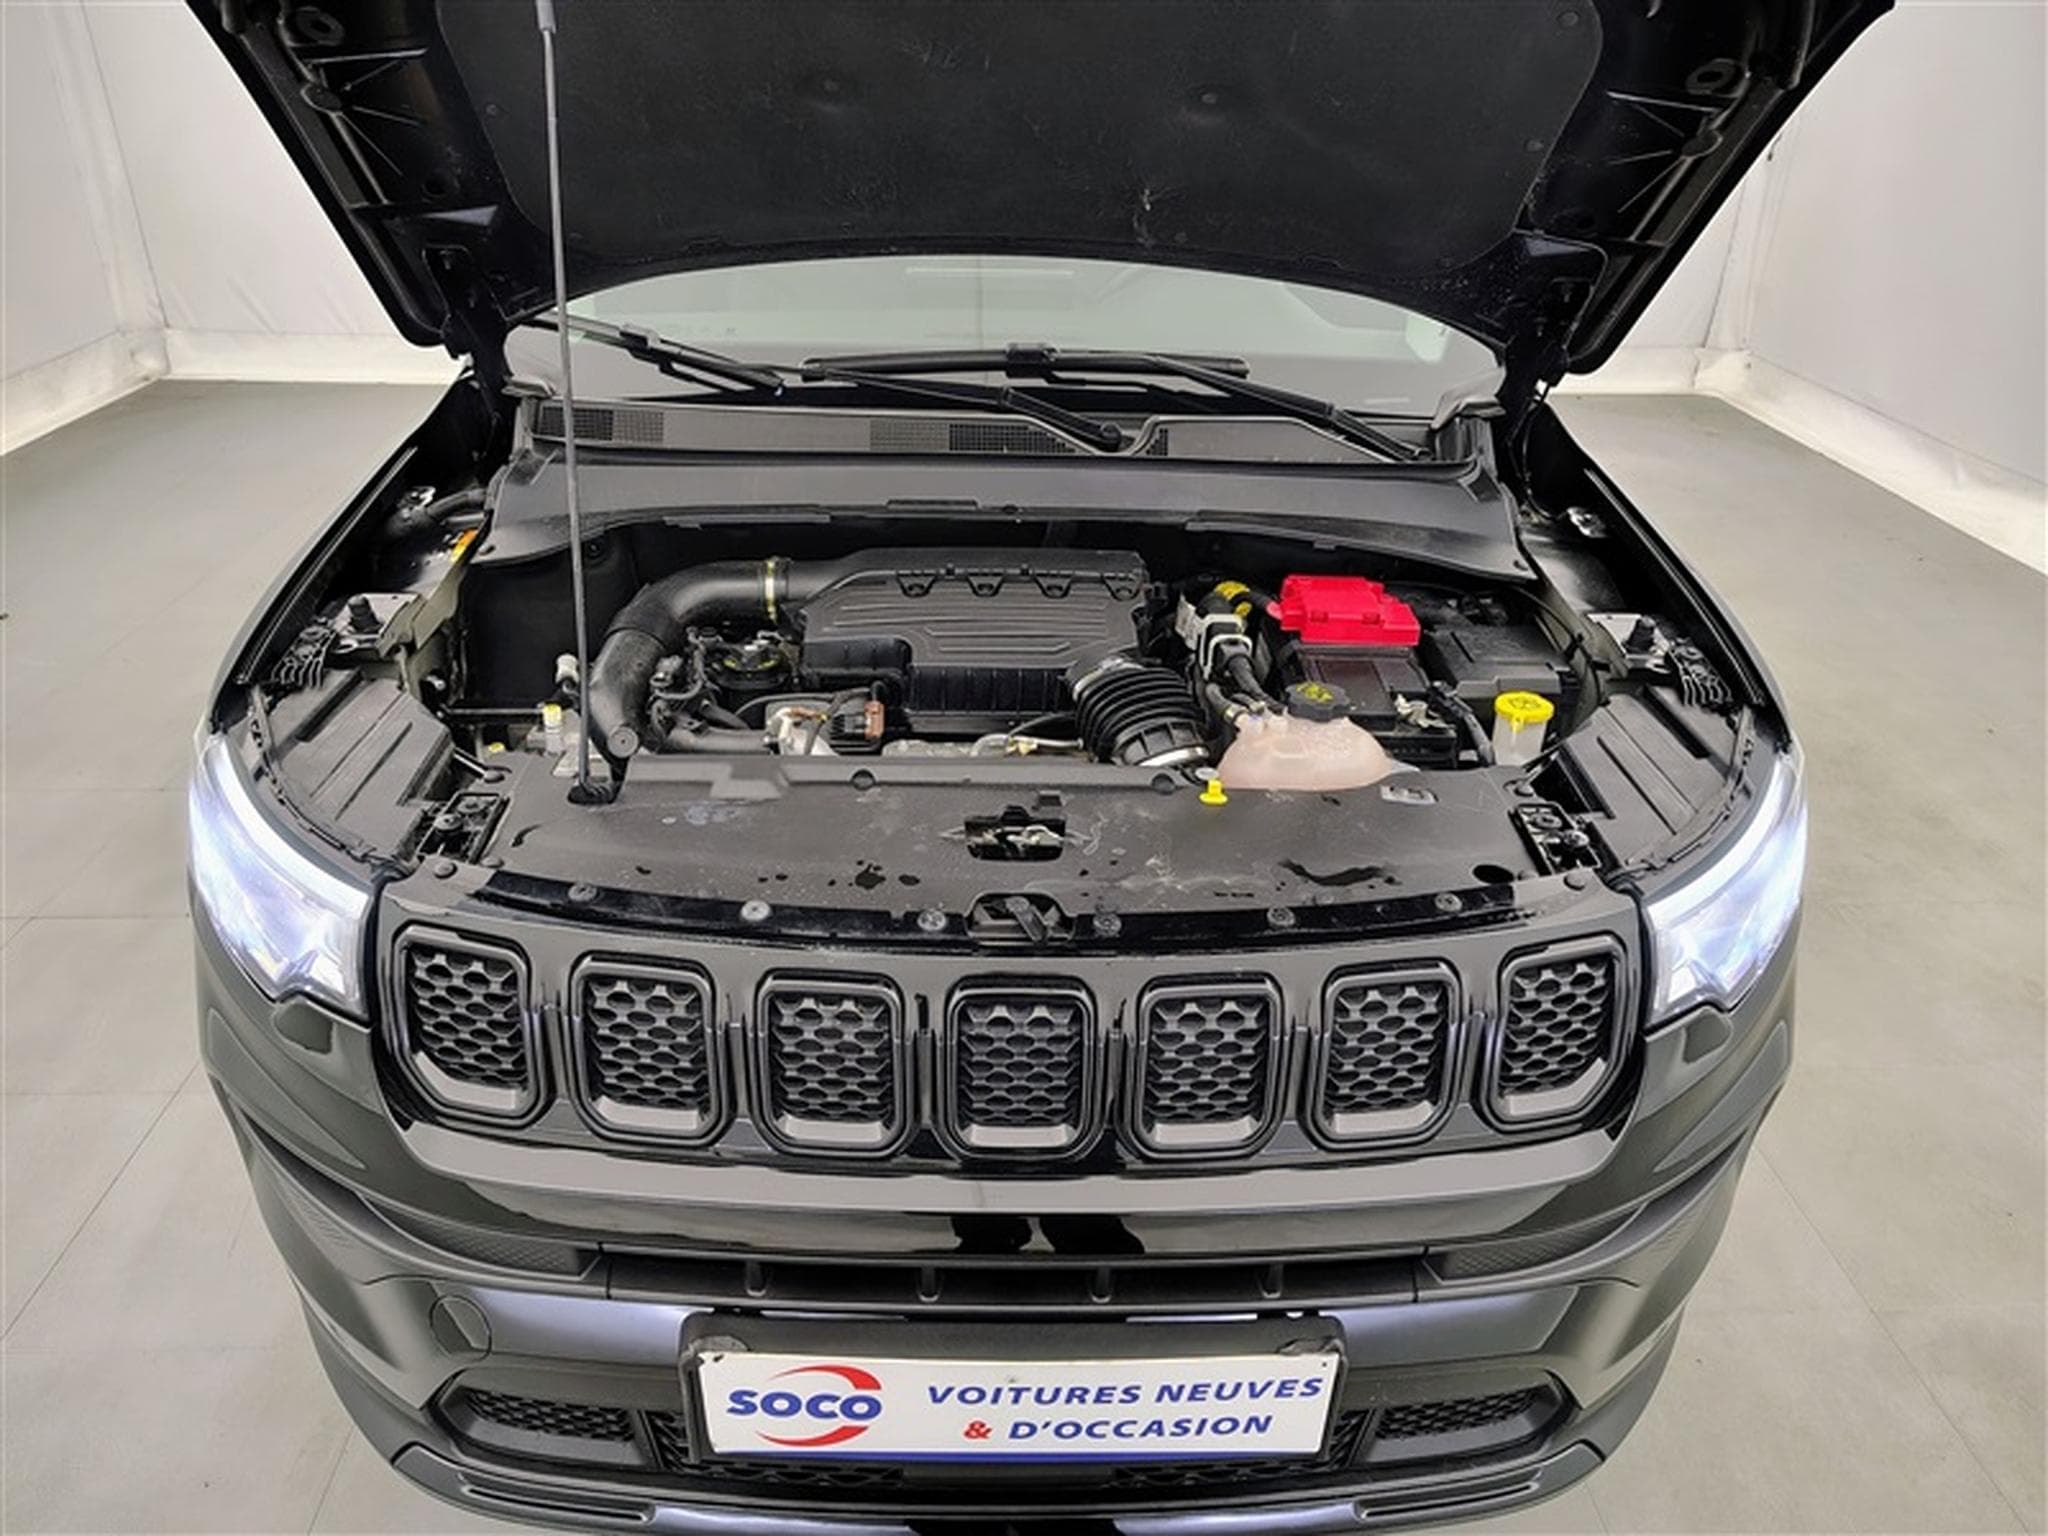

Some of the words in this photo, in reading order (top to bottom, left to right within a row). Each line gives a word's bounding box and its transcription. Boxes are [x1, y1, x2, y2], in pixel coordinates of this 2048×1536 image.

[726, 1389, 883, 1421] SOCO
[927, 1384, 1141, 1406] VOITURES
[1154, 1377, 1324, 1403] NEUVES
[962, 1420, 992, 1441] &
[1007, 1414, 1273, 1441] D'OCCASION
